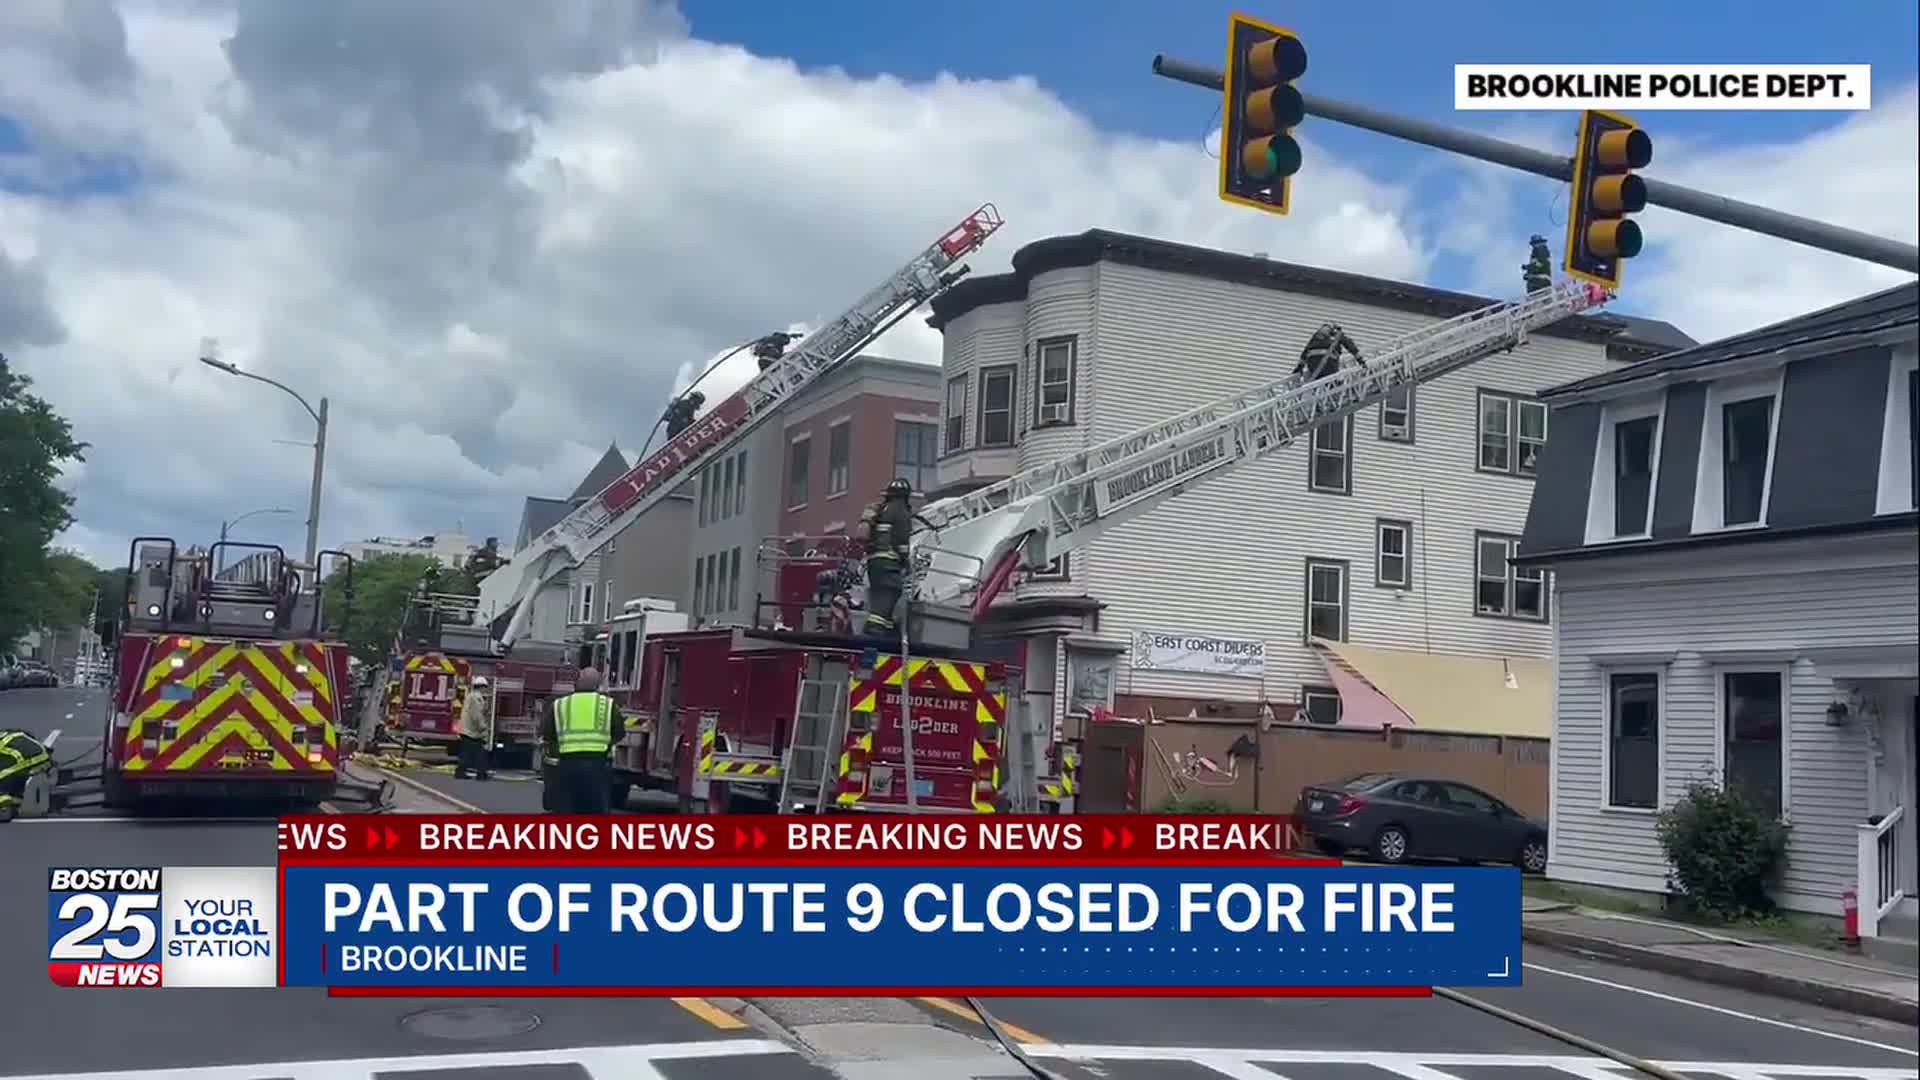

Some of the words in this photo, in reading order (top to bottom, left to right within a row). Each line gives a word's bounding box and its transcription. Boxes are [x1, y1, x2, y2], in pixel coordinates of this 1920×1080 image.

[1107, 459, 1173, 503] BROOKLINE
[1174, 441, 1216, 475] LADDER
[1154, 636, 1182, 649] EAST
[1185, 639, 1221, 653] COAST
[1224, 641, 1263, 657] DIVERS
